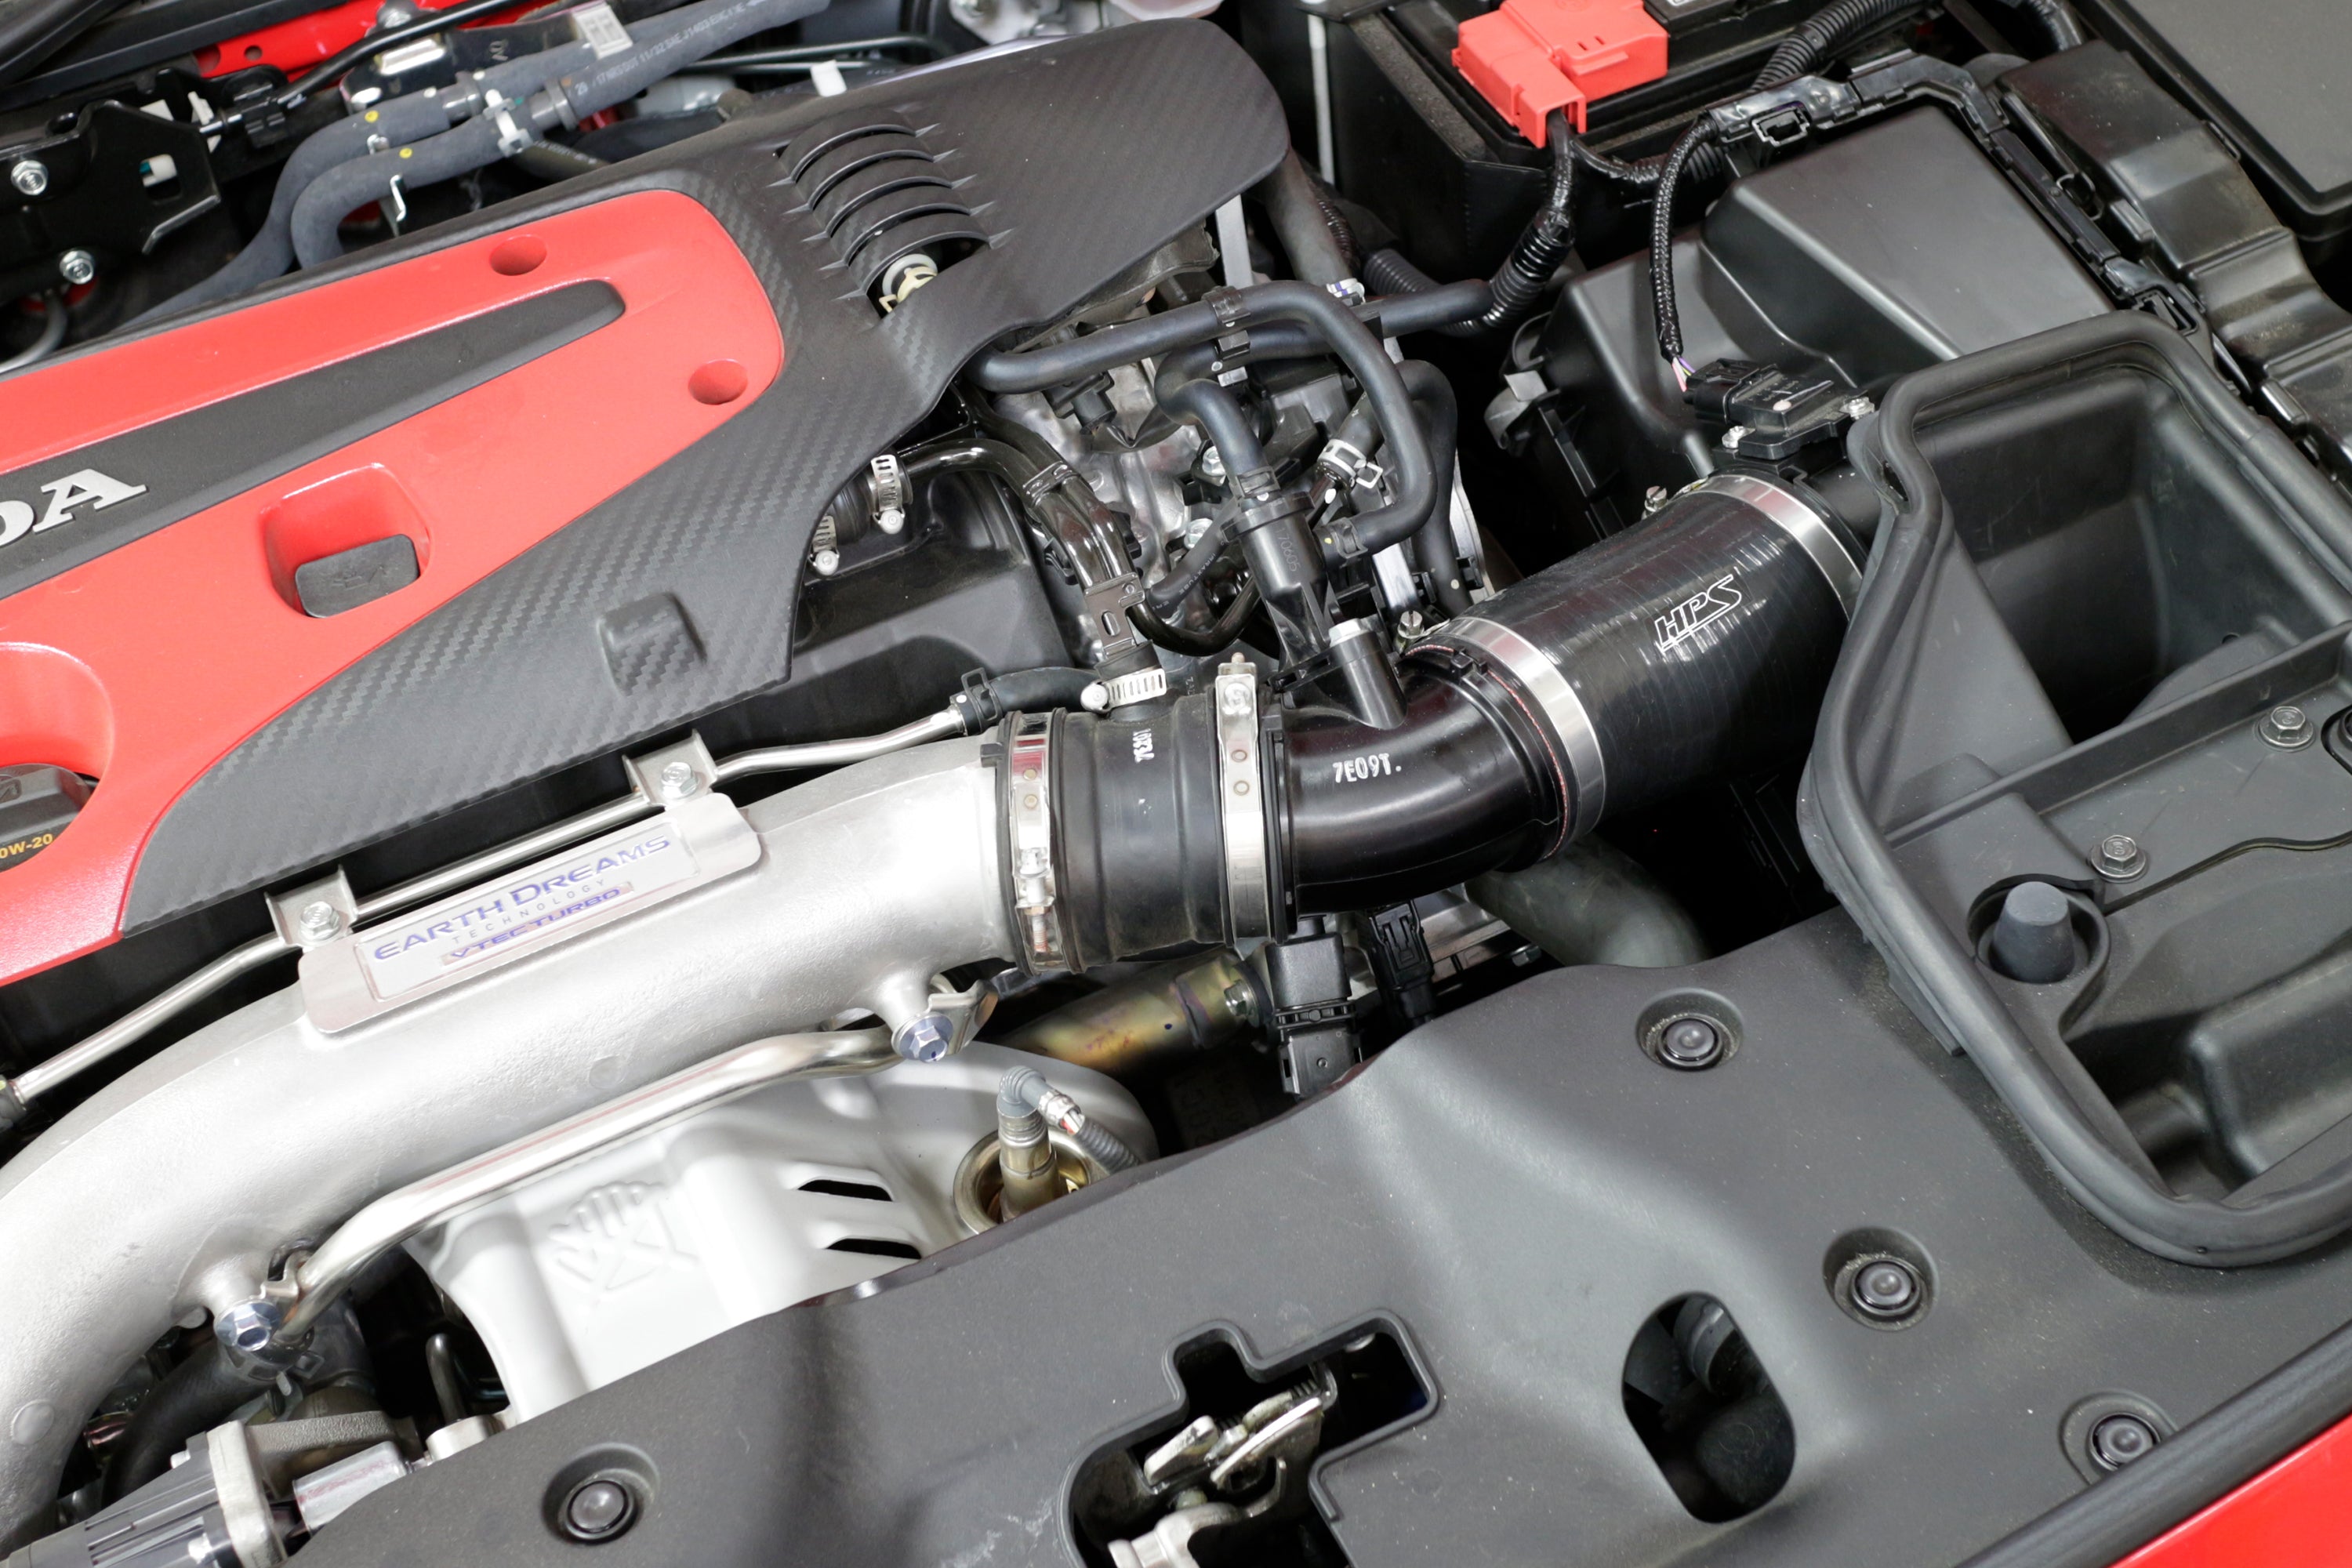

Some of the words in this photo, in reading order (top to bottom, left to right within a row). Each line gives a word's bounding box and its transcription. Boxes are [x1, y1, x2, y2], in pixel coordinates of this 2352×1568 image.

[1654, 573, 1742, 652] HPS
[0, 833, 53, 859] 0W-20
[374, 899, 504, 960] EARTH
[510, 834, 670, 906] DREAMS
[452, 878, 604, 944] TECHNOLOGY
